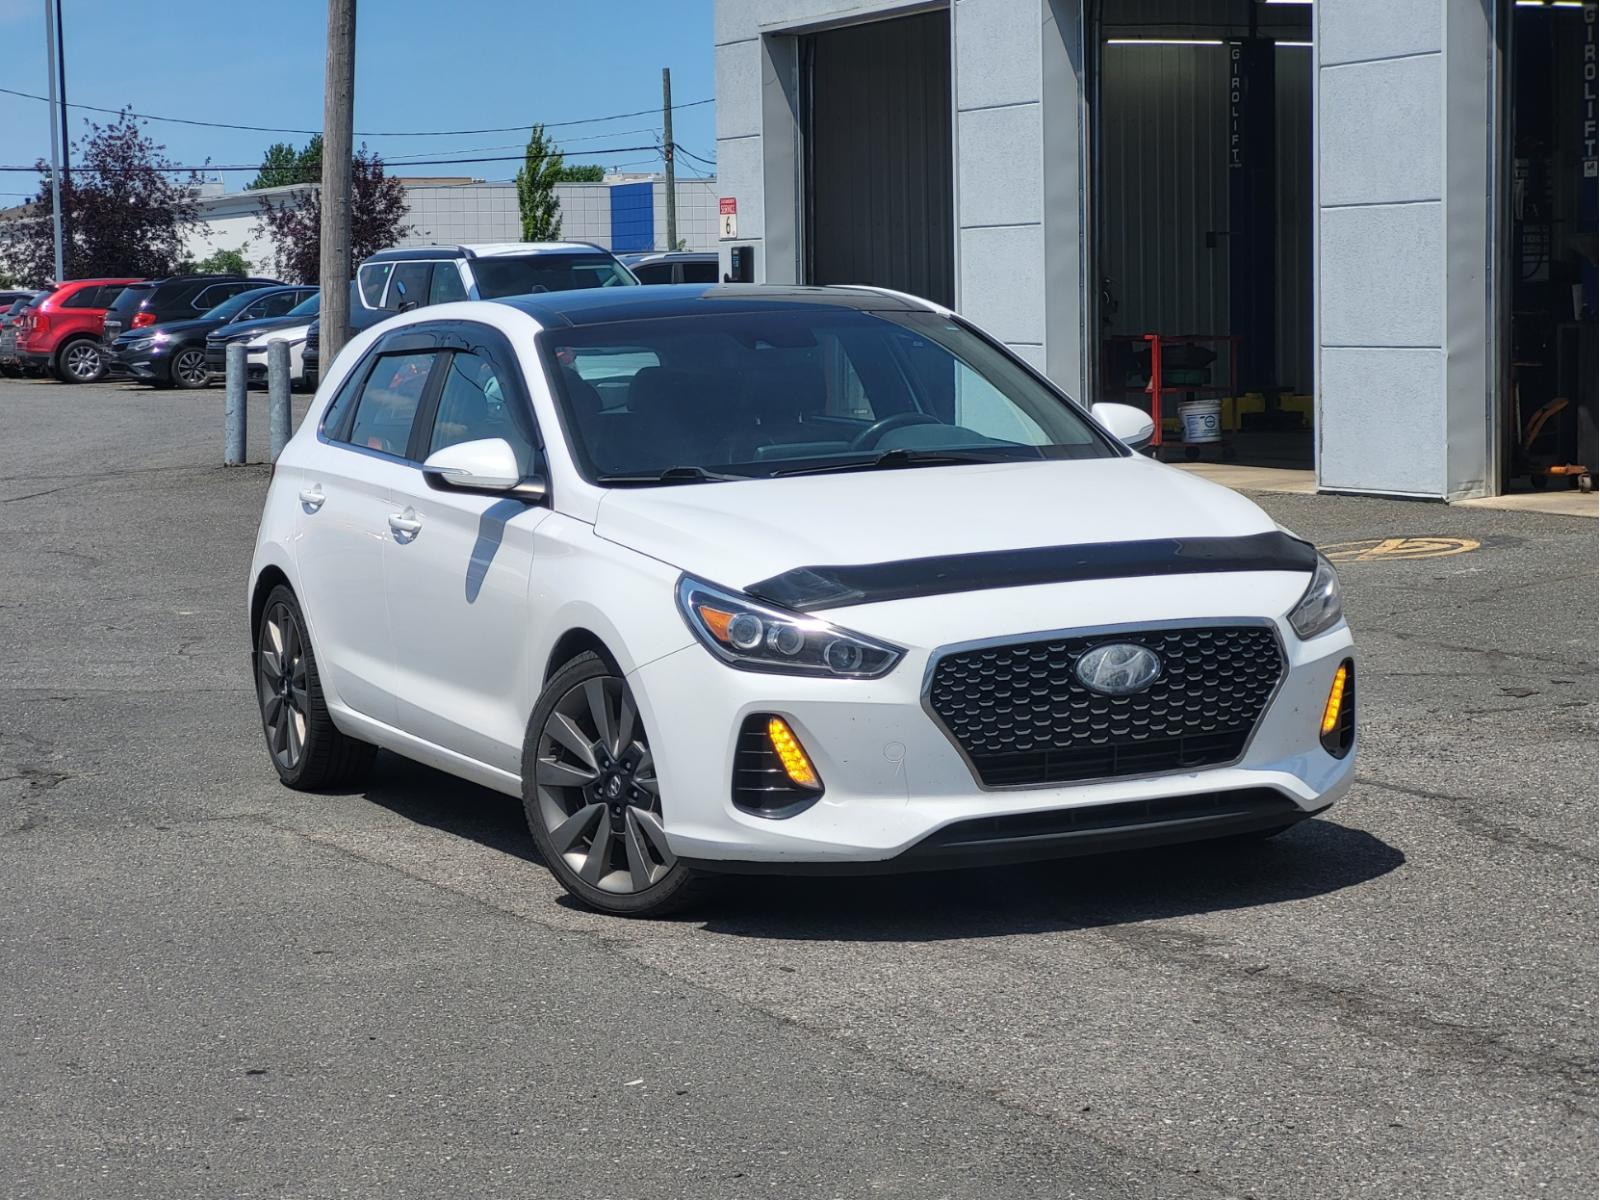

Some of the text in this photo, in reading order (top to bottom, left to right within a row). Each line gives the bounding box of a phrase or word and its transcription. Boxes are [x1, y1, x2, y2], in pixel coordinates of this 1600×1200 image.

[1231, 48, 1240, 162] GIROLIFT
[1584, 6, 1596, 157] GIROLIFT
[726, 216, 730, 234] 6
